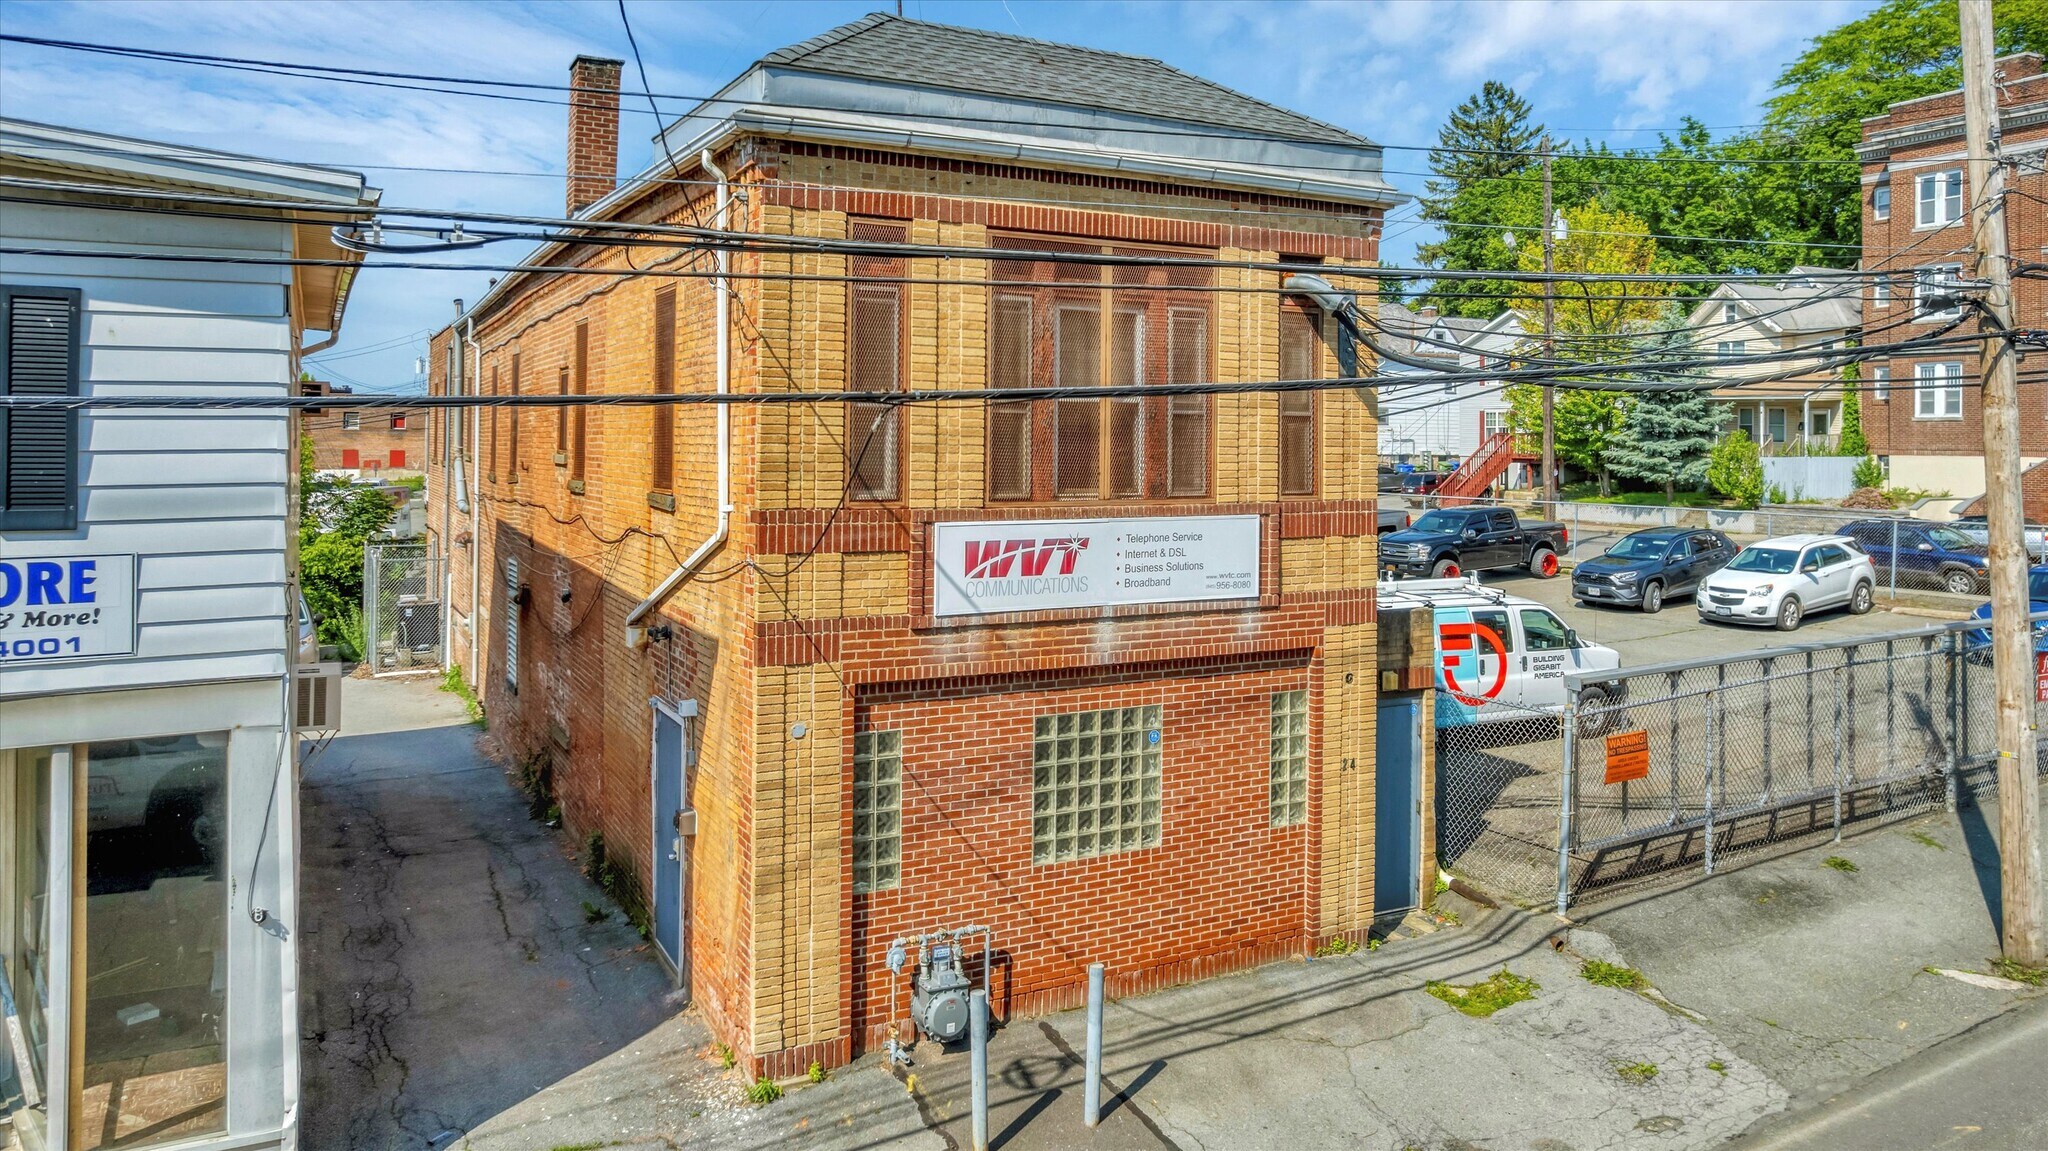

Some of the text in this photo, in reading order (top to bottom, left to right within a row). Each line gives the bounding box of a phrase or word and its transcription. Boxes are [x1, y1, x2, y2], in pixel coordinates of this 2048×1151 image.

[1126, 532, 1203, 544] Telephone Service
[964, 537, 1090, 579] WVT
[1125, 548, 1187, 559] Internet & DSL
[1124, 561, 1204, 574] Business Solutions
[965, 576, 1089, 598] COMMUNICATIONS
[1124, 577, 1171, 588] Broadband
[1216, 580, 1251, 590] 956-8080
[22, 607, 101, 628] More!
[1533, 655, 1565, 663] BUILDING
[1533, 663, 1561, 671] GIGABIT
[1534, 671, 1565, 679] AMERICA
[1608, 734, 1646, 749] WARNING!
[1608, 743, 1647, 756] NO TRESPASSING
[1342, 757, 1356, 772] 24
